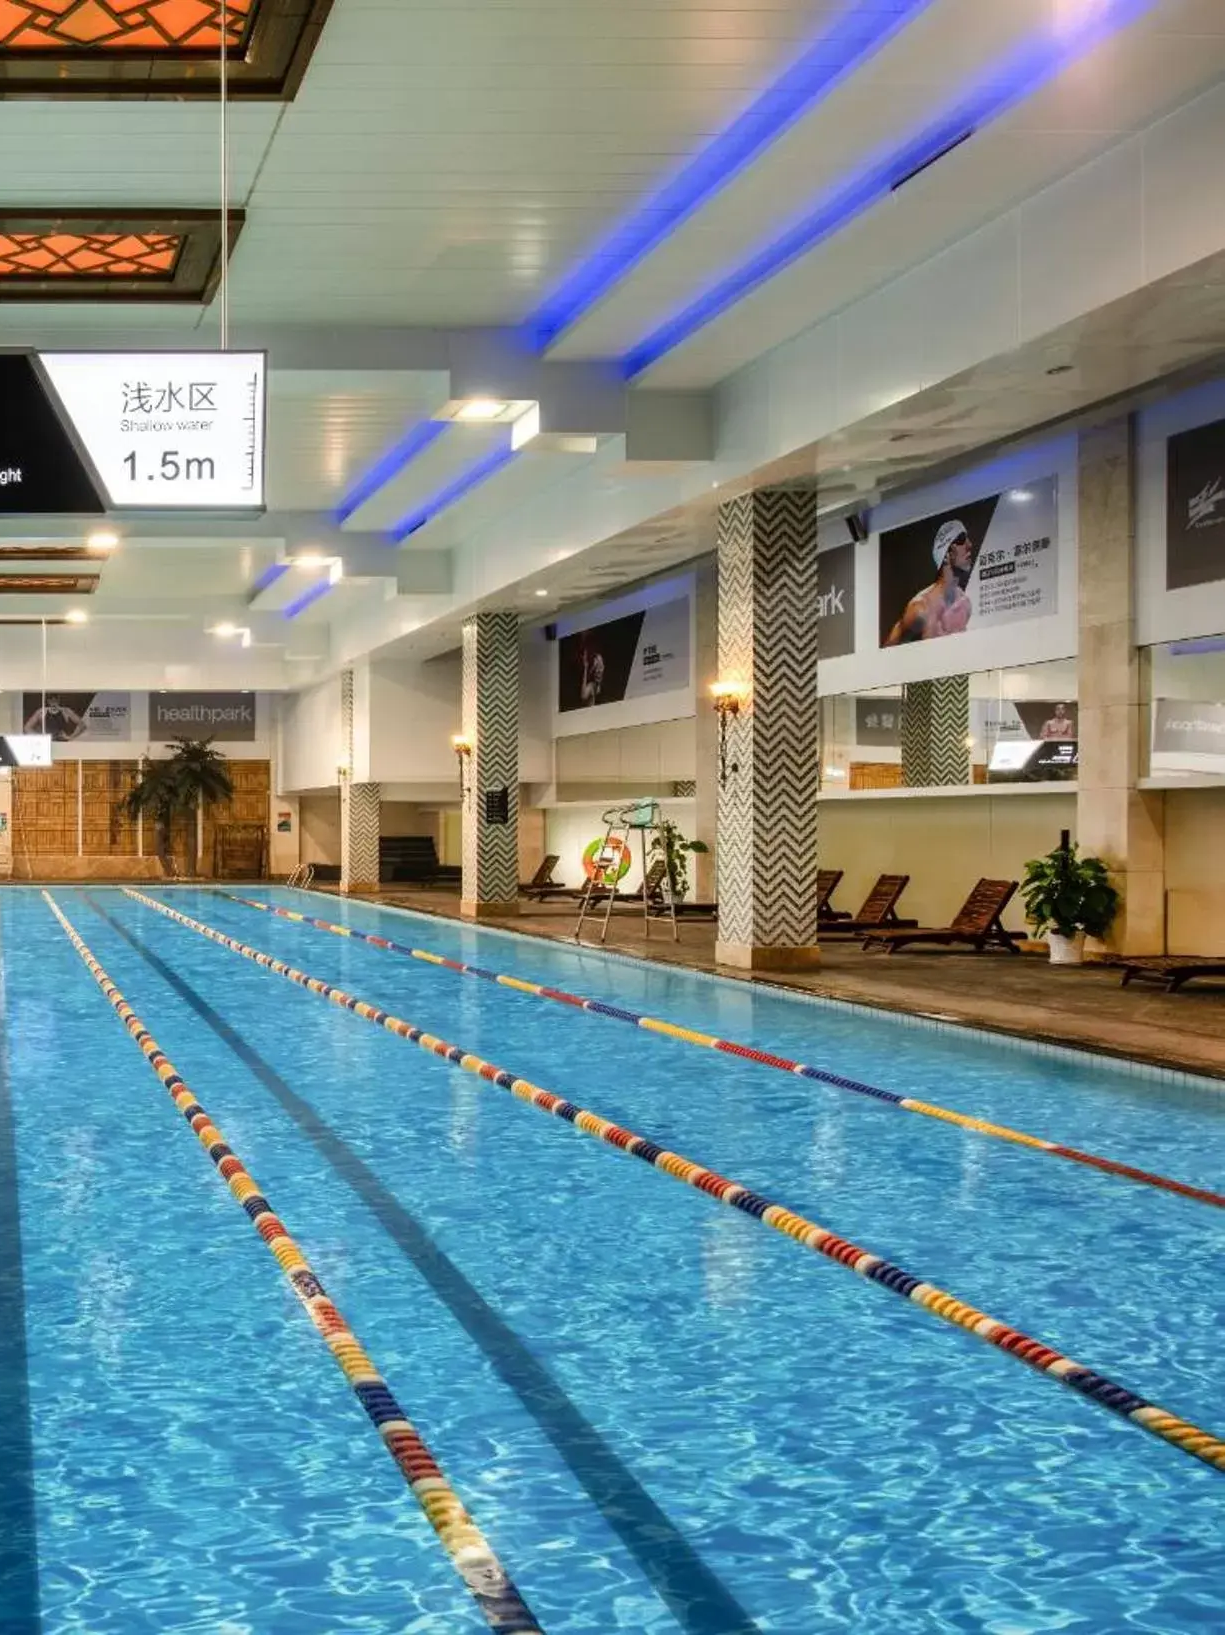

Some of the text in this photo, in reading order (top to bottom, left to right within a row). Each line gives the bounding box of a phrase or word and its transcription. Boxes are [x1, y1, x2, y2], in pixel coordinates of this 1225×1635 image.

[121, 381, 218, 413] 浅水区
[120, 419, 213, 432] Shallow water
[123, 450, 215, 481] 1.5m
[157, 705, 252, 723] healthpark
